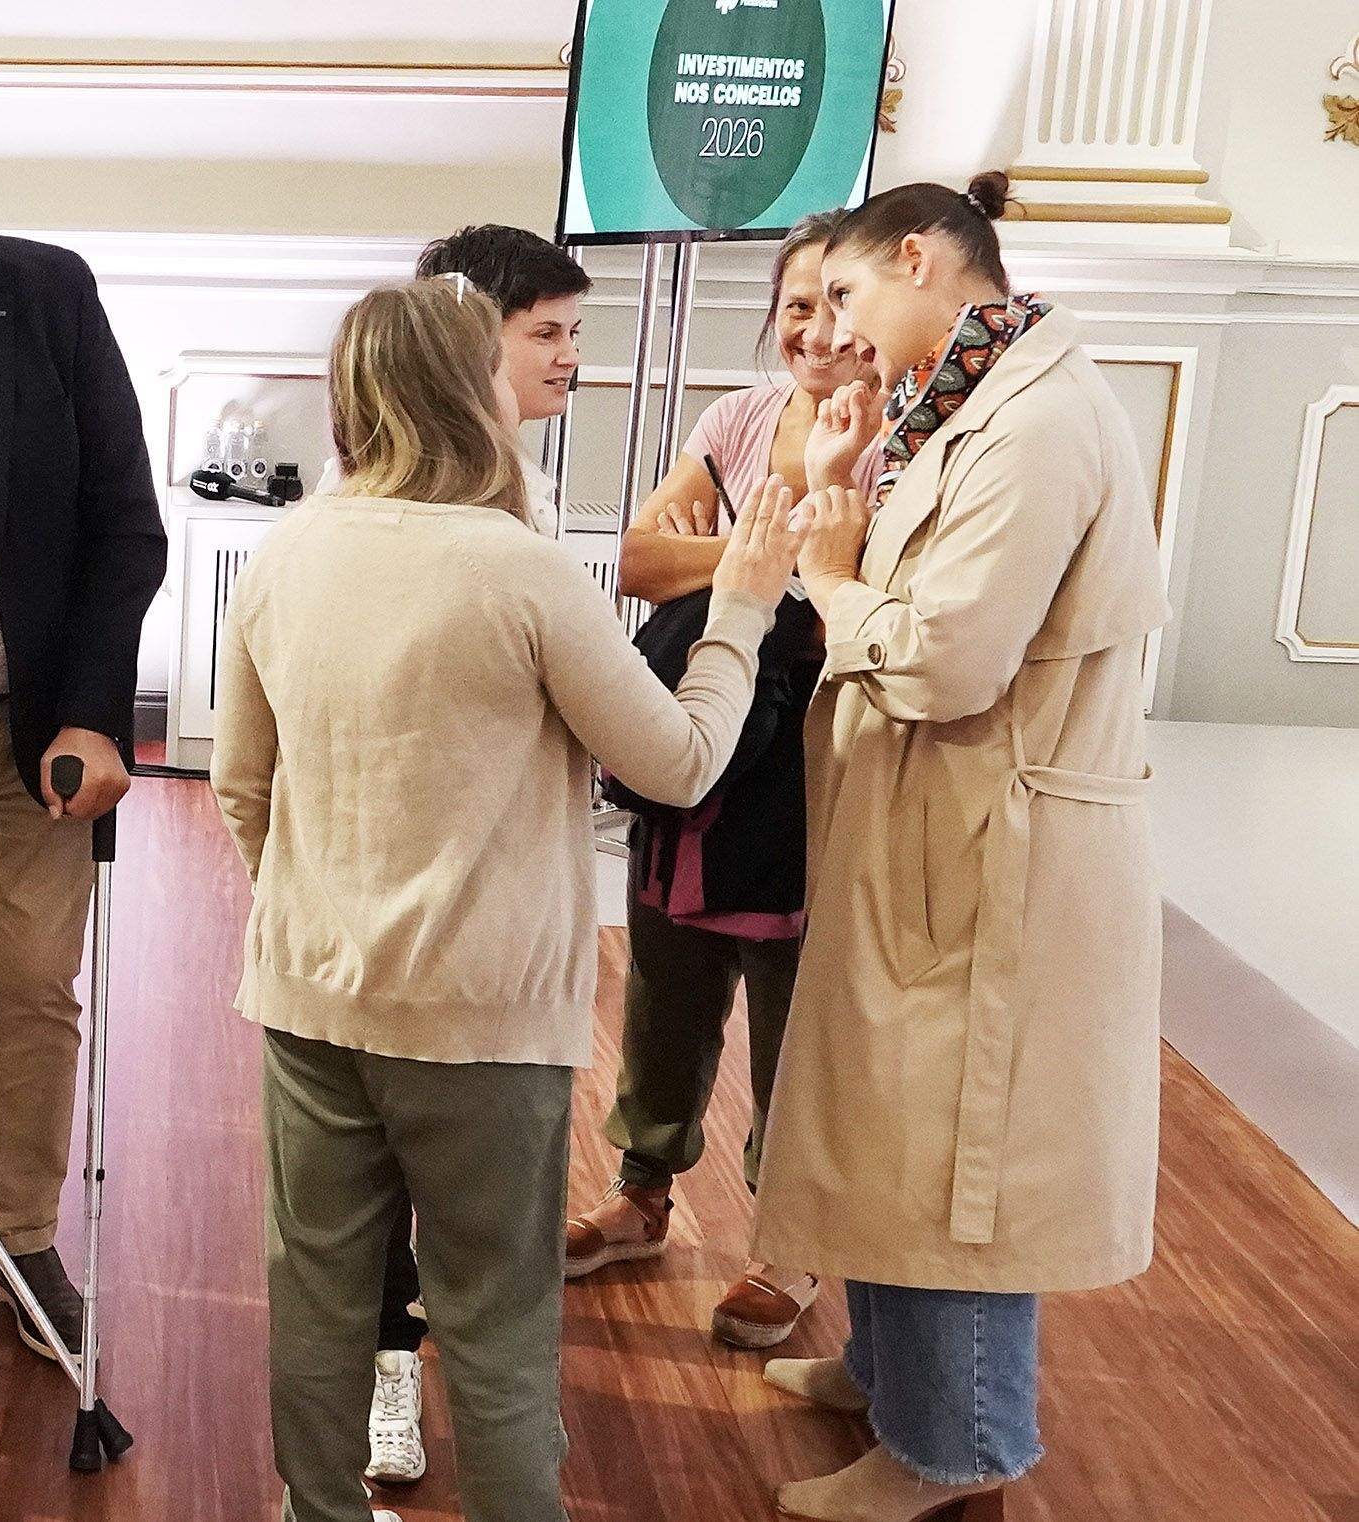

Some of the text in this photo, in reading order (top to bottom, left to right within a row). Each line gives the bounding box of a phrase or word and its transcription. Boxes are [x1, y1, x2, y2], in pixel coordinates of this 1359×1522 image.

[677, 53, 805, 80] INVESTIMENTOS
[674, 81, 802, 107] NOS CONCELLOS
[698, 117, 765, 157] 2026
